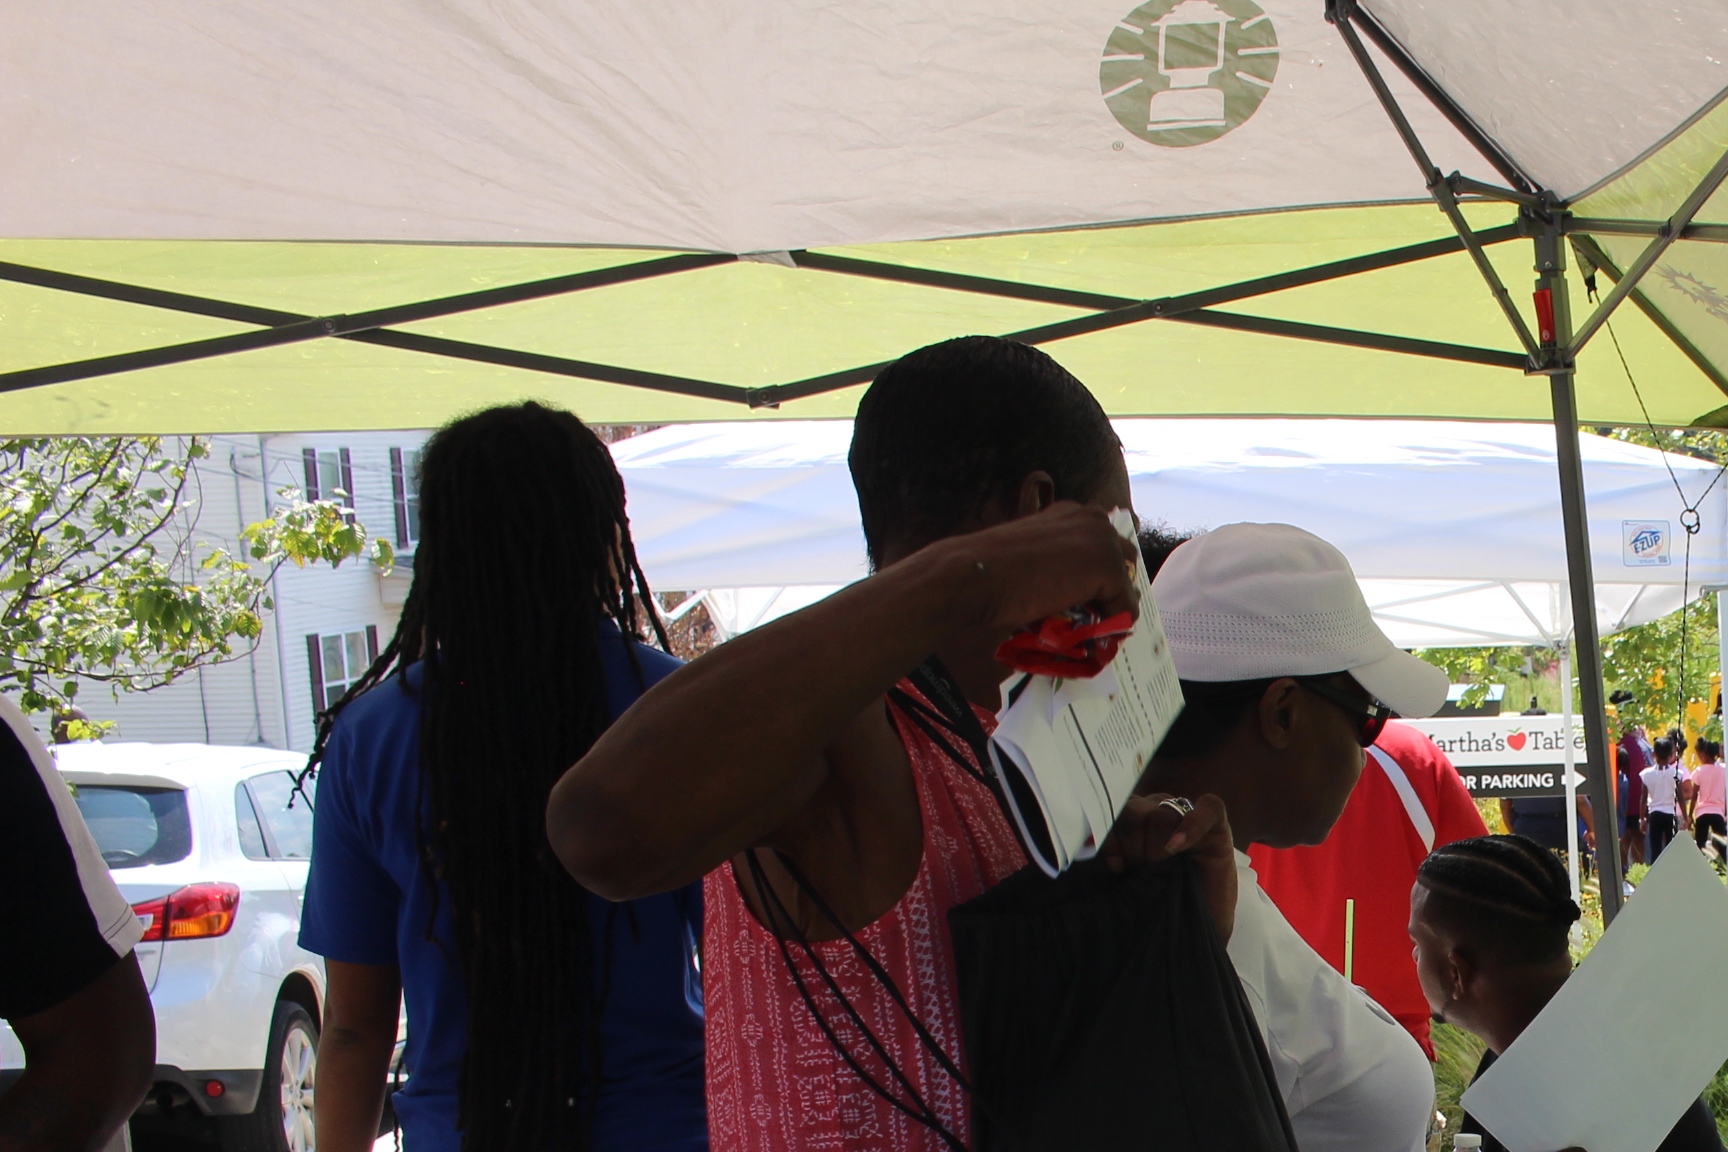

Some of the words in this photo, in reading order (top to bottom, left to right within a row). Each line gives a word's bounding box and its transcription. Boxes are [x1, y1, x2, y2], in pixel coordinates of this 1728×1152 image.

[1428, 731, 1505, 753] artha's
[1528, 730, 1585, 750] Tabe
[1481, 772, 1554, 790] PARKING
